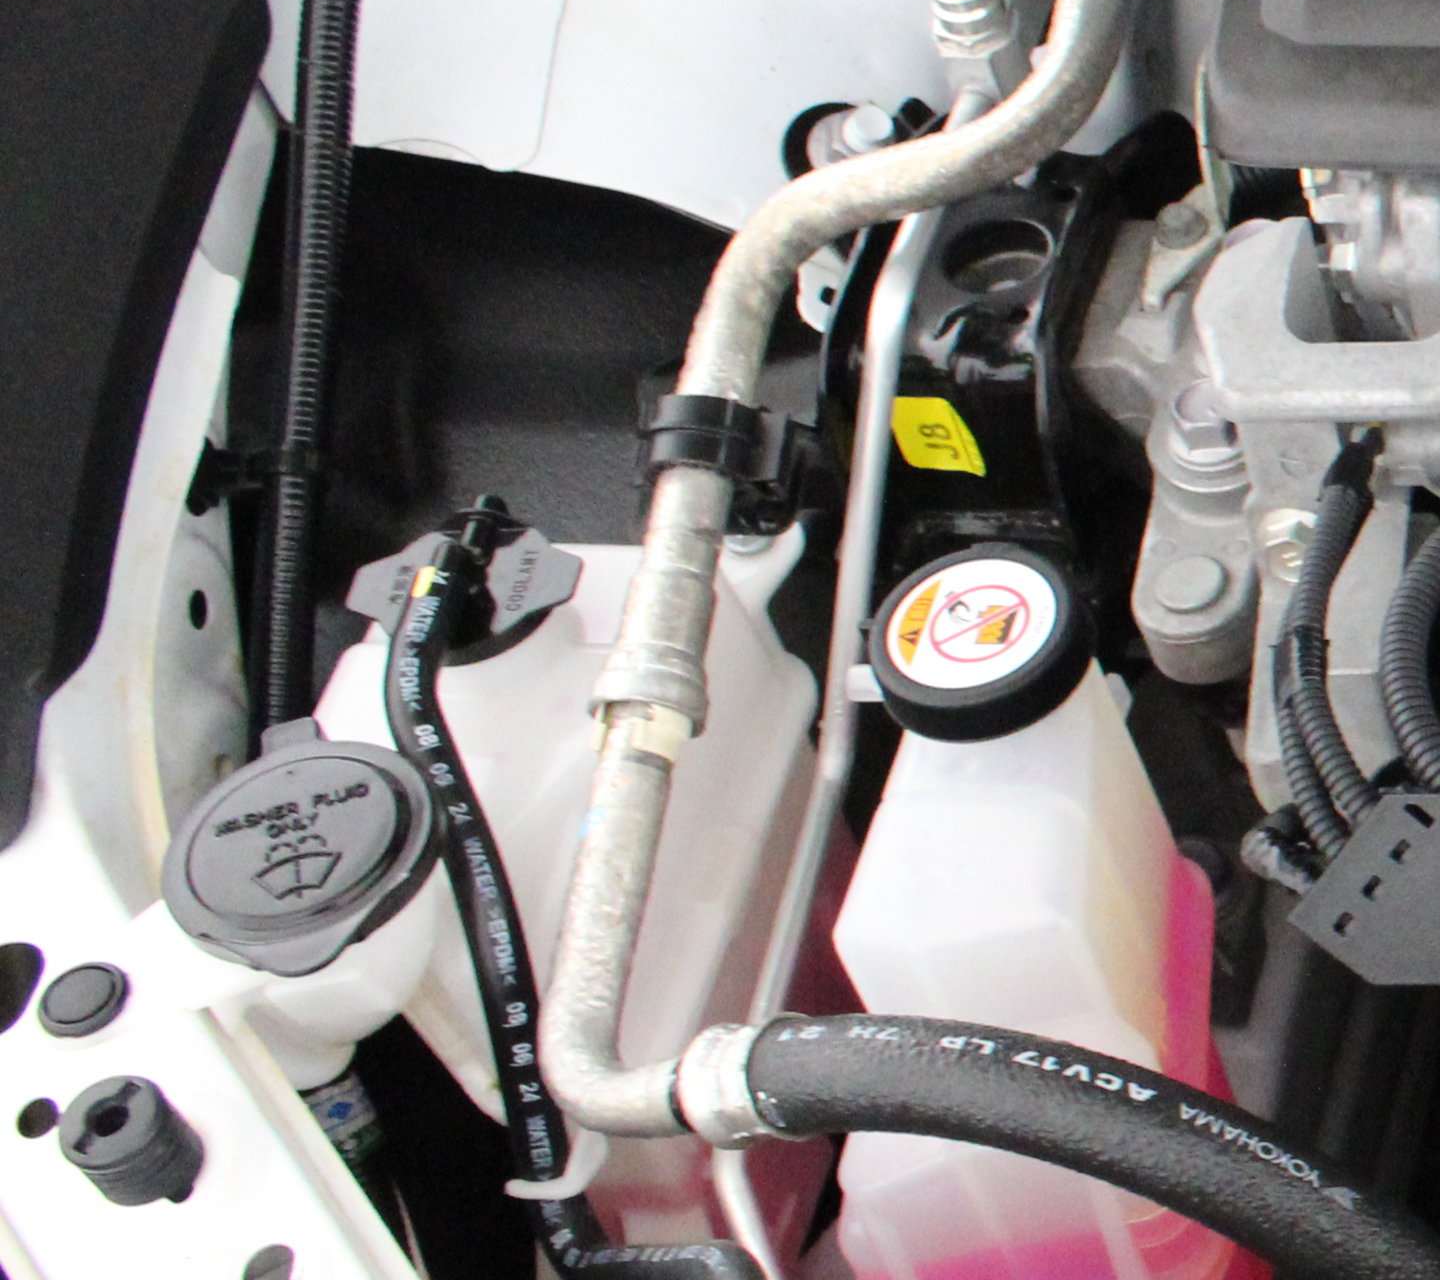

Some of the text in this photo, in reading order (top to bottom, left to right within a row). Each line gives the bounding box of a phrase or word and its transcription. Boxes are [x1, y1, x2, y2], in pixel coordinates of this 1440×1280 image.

[507, 549, 540, 612] COOLANT
[405, 596, 440, 643] WATER
[464, 836, 500, 902] WATER
[525, 1116, 554, 1169] WATER
[938, 1035, 997, 1056] LP
[1012, 1050, 1158, 1102] ACV17
[1178, 1102, 1321, 1188] YOKOHAMA
